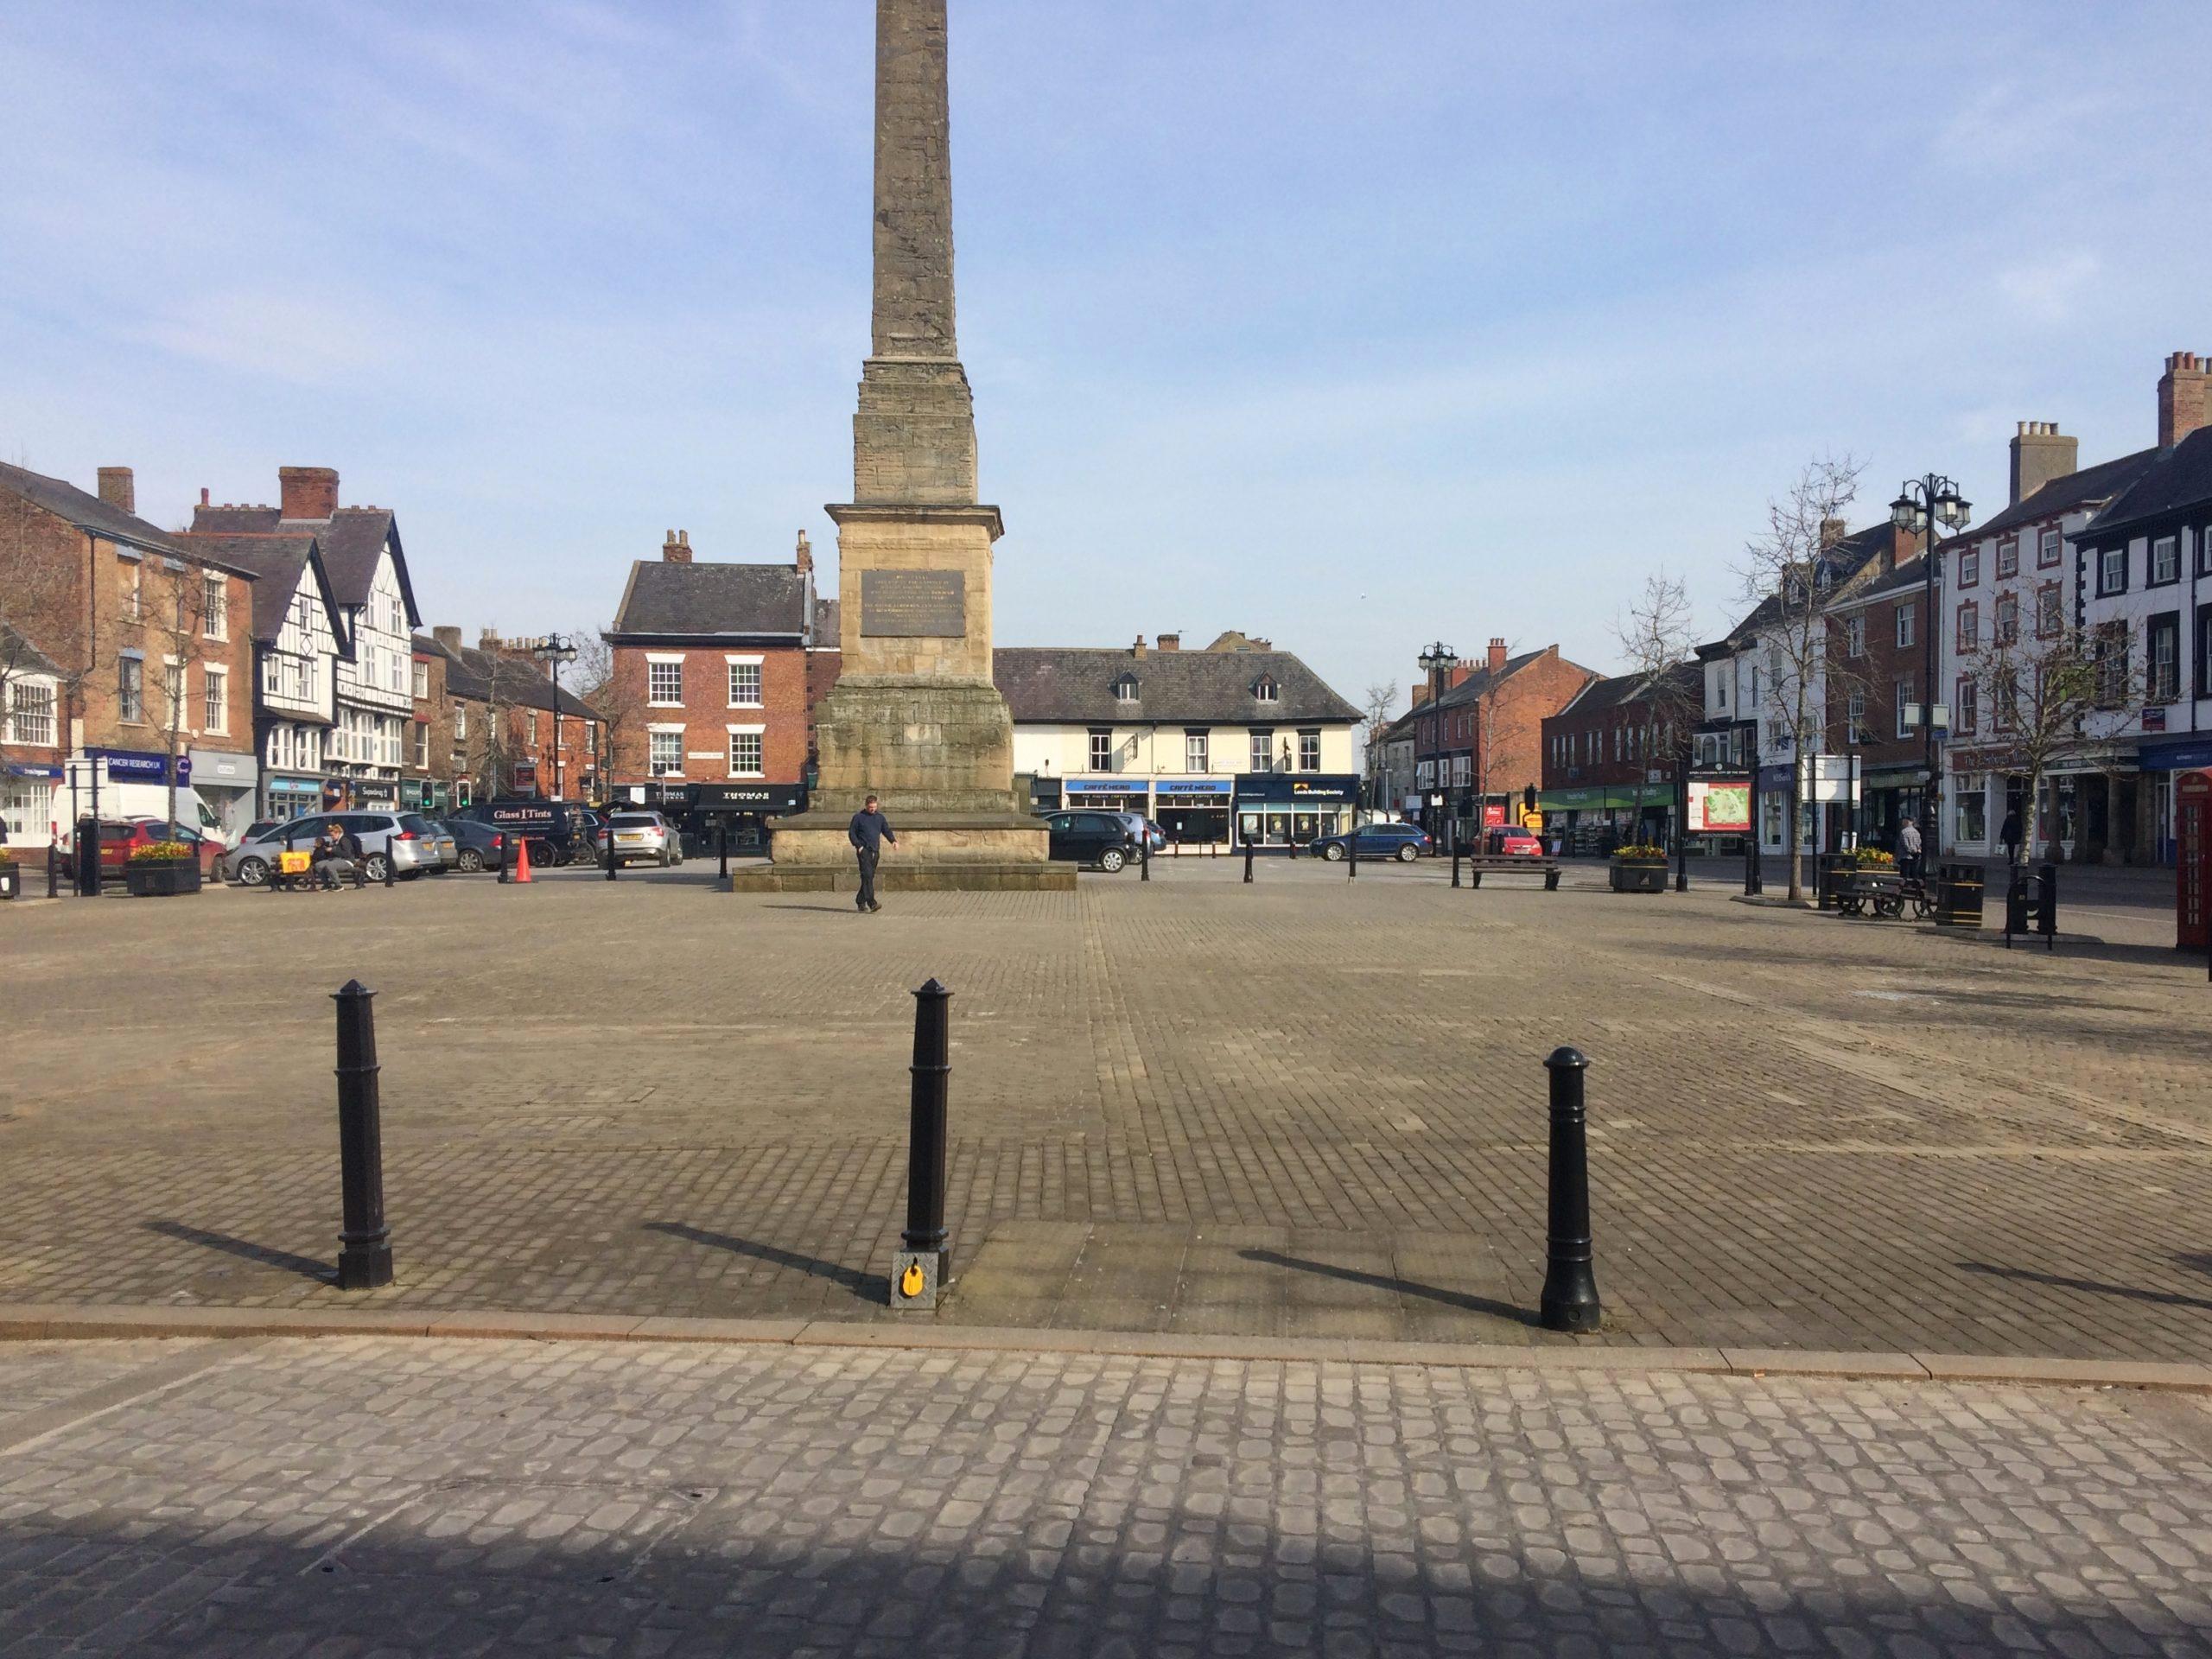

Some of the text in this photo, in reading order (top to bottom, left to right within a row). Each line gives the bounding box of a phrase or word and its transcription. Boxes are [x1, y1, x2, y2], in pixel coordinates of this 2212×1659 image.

[108, 758, 129, 766] CANCER
[129, 760, 153, 768] RESEARCH
[362, 786, 384, 798] Superdrug
[493, 808, 552, 819] Glass 1 Tints
